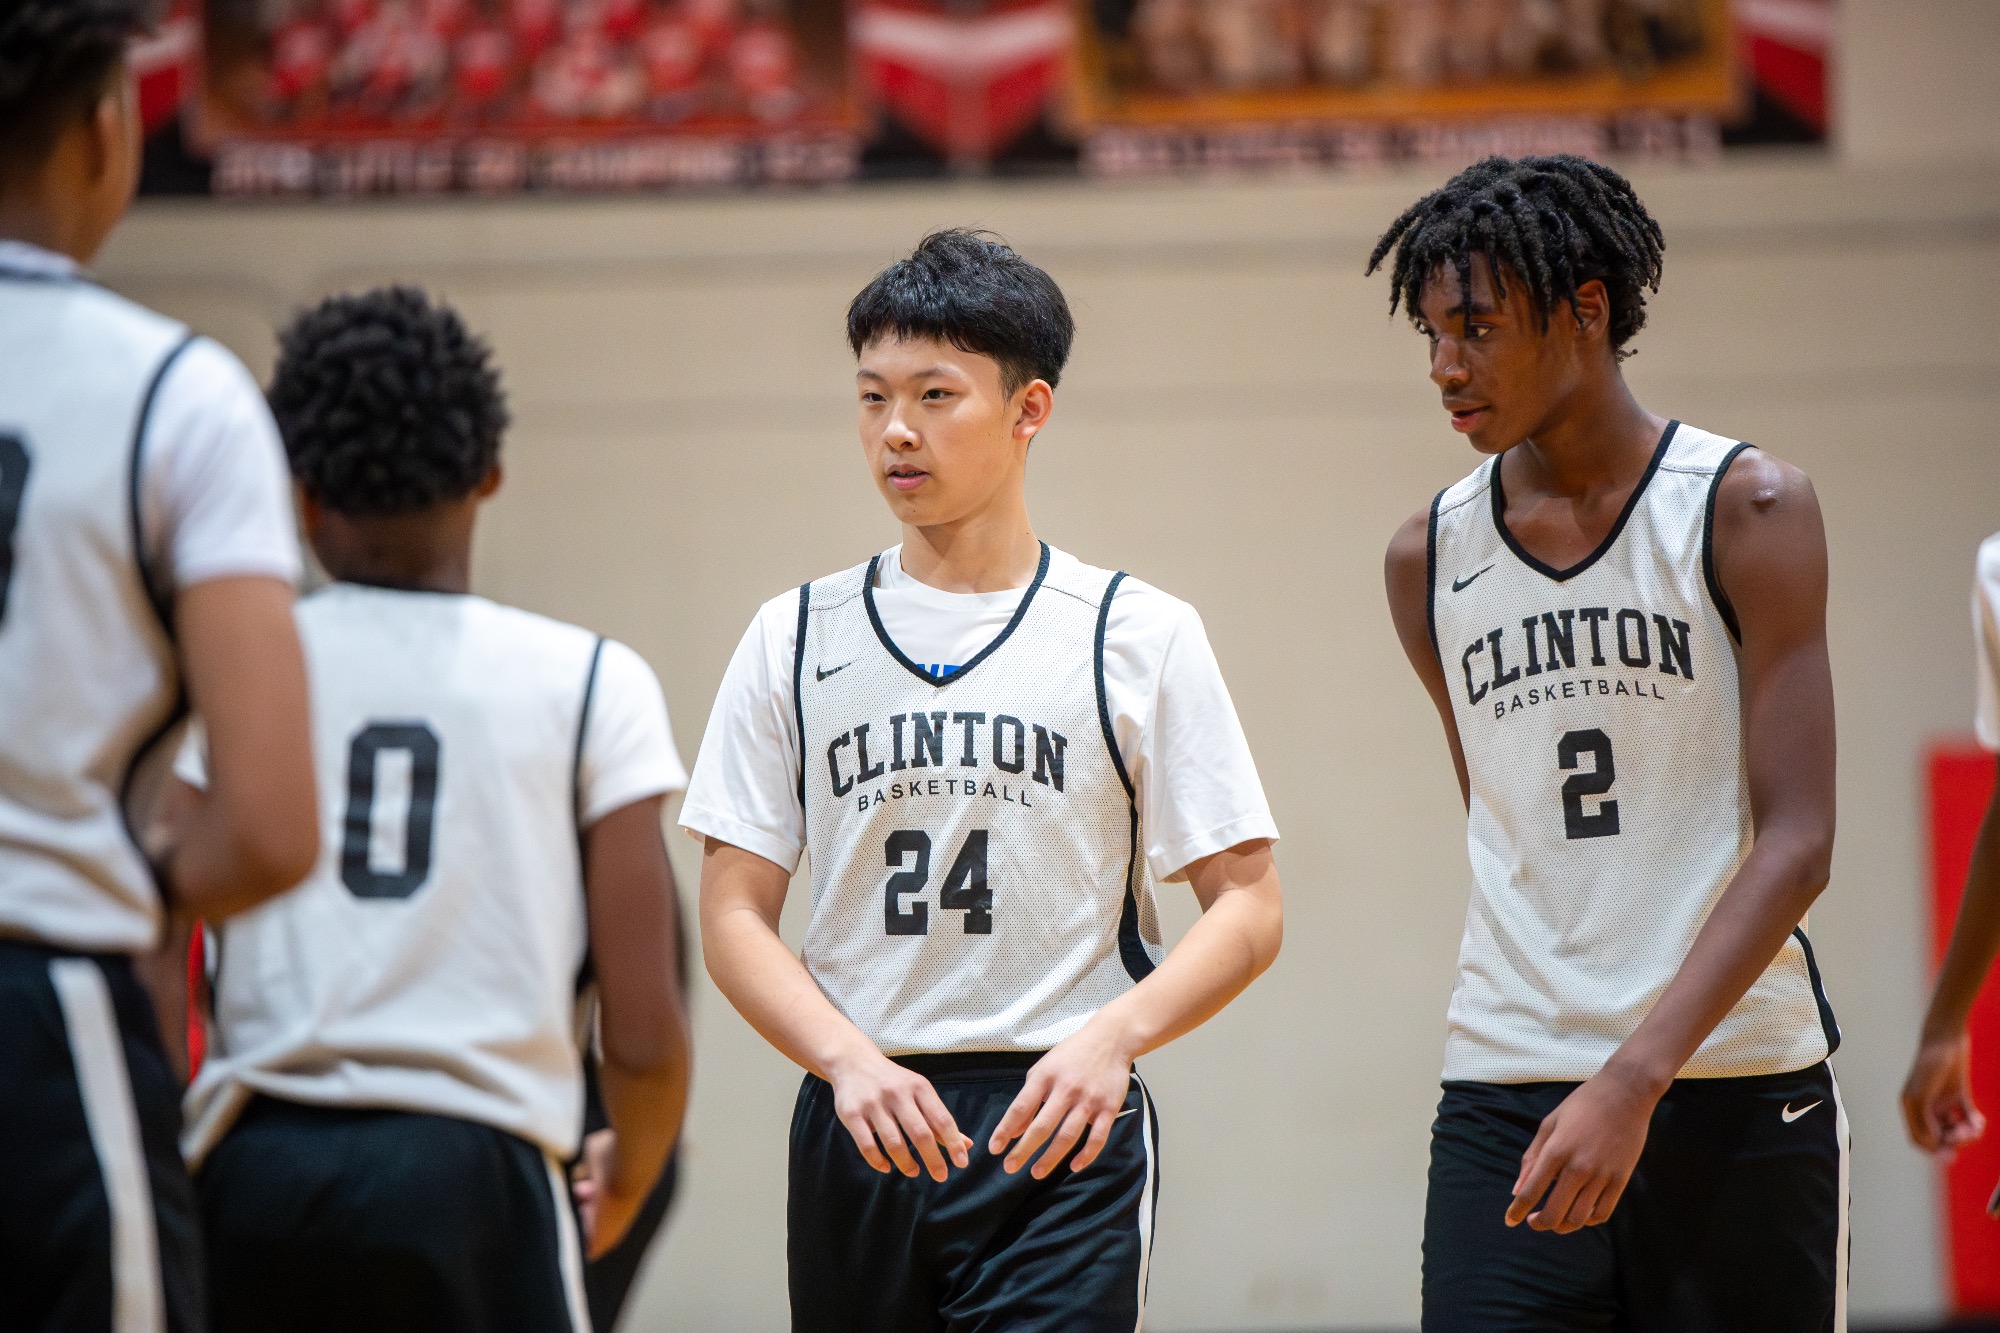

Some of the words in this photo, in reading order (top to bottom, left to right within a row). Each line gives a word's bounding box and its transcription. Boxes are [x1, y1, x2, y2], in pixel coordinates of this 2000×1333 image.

[1461, 607, 1695, 706] CLINTON
[1494, 679, 1665, 720] BASKETBALL
[827, 711, 1068, 799] CLINTON
[858, 779, 1032, 812] BASKETBALL
[1557, 728, 1620, 840] 2
[340, 719, 441, 901] 0
[884, 829, 993, 936] 24
